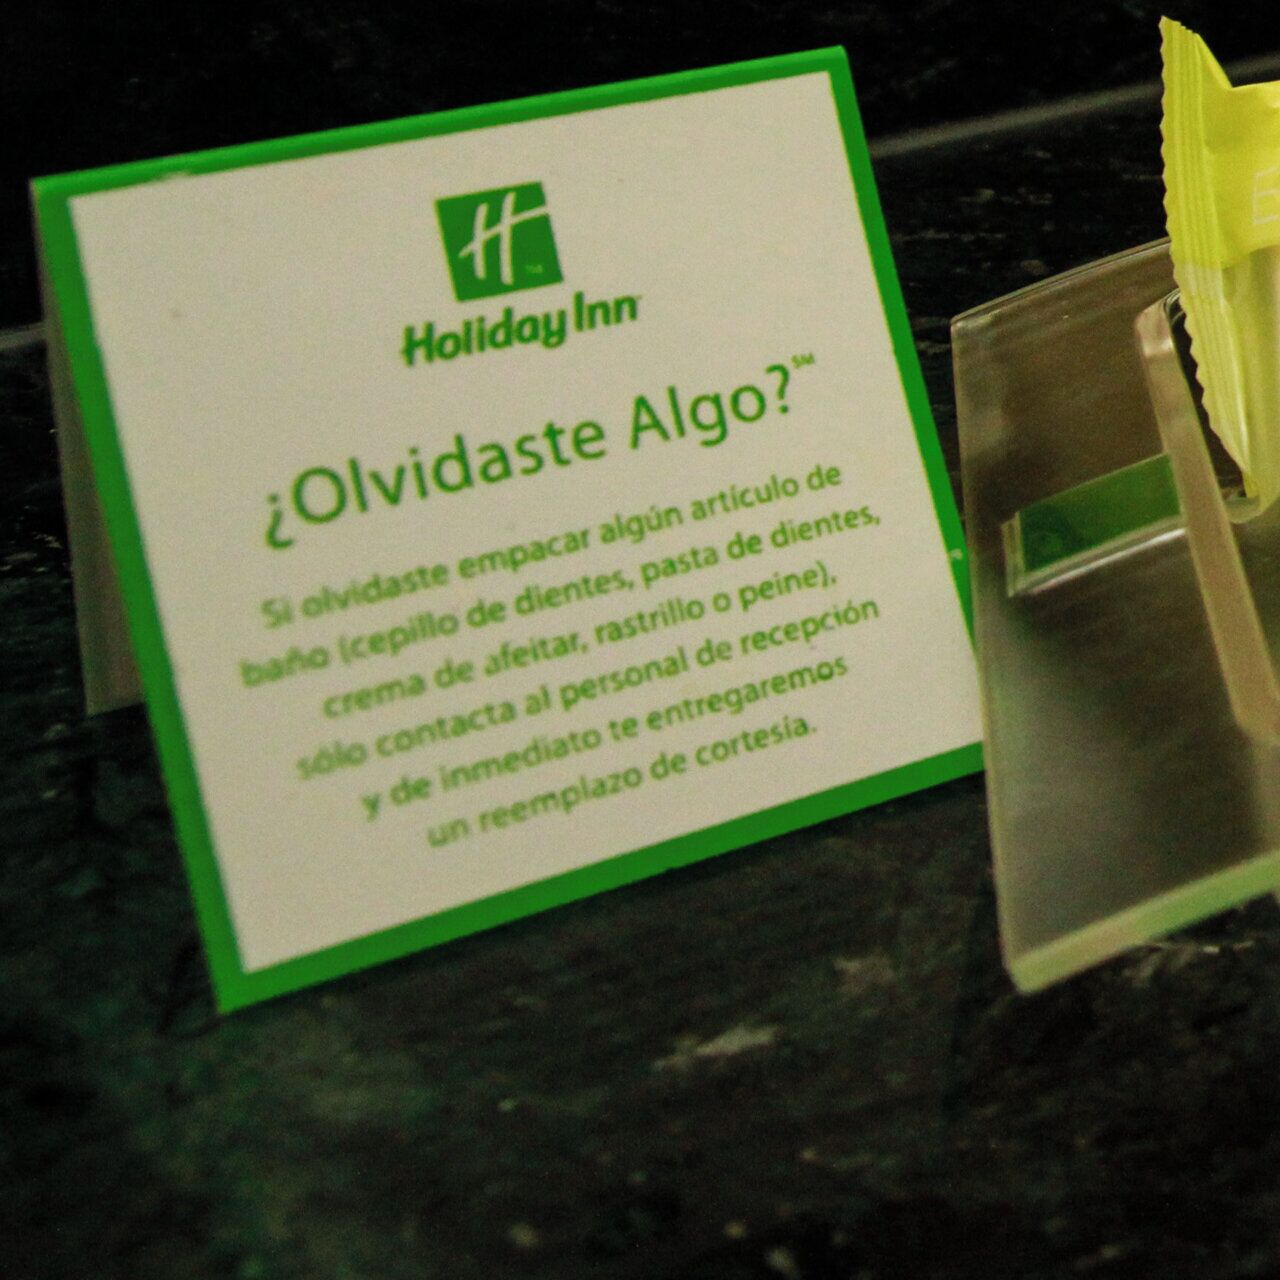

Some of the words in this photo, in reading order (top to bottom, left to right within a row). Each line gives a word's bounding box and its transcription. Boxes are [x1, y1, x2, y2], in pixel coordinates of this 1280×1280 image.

[401, 306, 568, 368] Holiday
[574, 290, 638, 332] Inn
[265, 421, 607, 551] ¿Olvidaste
[629, 363, 790, 450] Algo?
[301, 564, 449, 618] olvidaste
[457, 528, 590, 579] empacar
[599, 505, 684, 543] algún
[691, 473, 800, 521] artículo
[806, 463, 842, 492] de
[336, 611, 460, 666] (cepillo
[465, 597, 506, 629] de
[514, 568, 635, 617] dientes,
[640, 545, 720, 590] pasta
[726, 531, 763, 561] de
[769, 504, 881, 550] dientes,
[322, 672, 427, 719] crema
[433, 656, 475, 690] de
[484, 631, 589, 678] afeitar,
[593, 596, 706, 646] rastrillo
[712, 591, 732, 614] o
[374, 700, 517, 758] contacta
[524, 683, 551, 716] al
[559, 645, 689, 712] personal
[695, 637, 733, 668] de
[739, 597, 881, 655] recepción
[360, 792, 382, 822] y
[389, 774, 433, 807] de
[439, 727, 603, 793] inmediato
[608, 717, 639, 742] te
[645, 654, 849, 731] entregaremos
[427, 818, 470, 849] un
[479, 765, 643, 833] reemplazo
[649, 751, 688, 781] de
[694, 714, 818, 767] cortesía.
